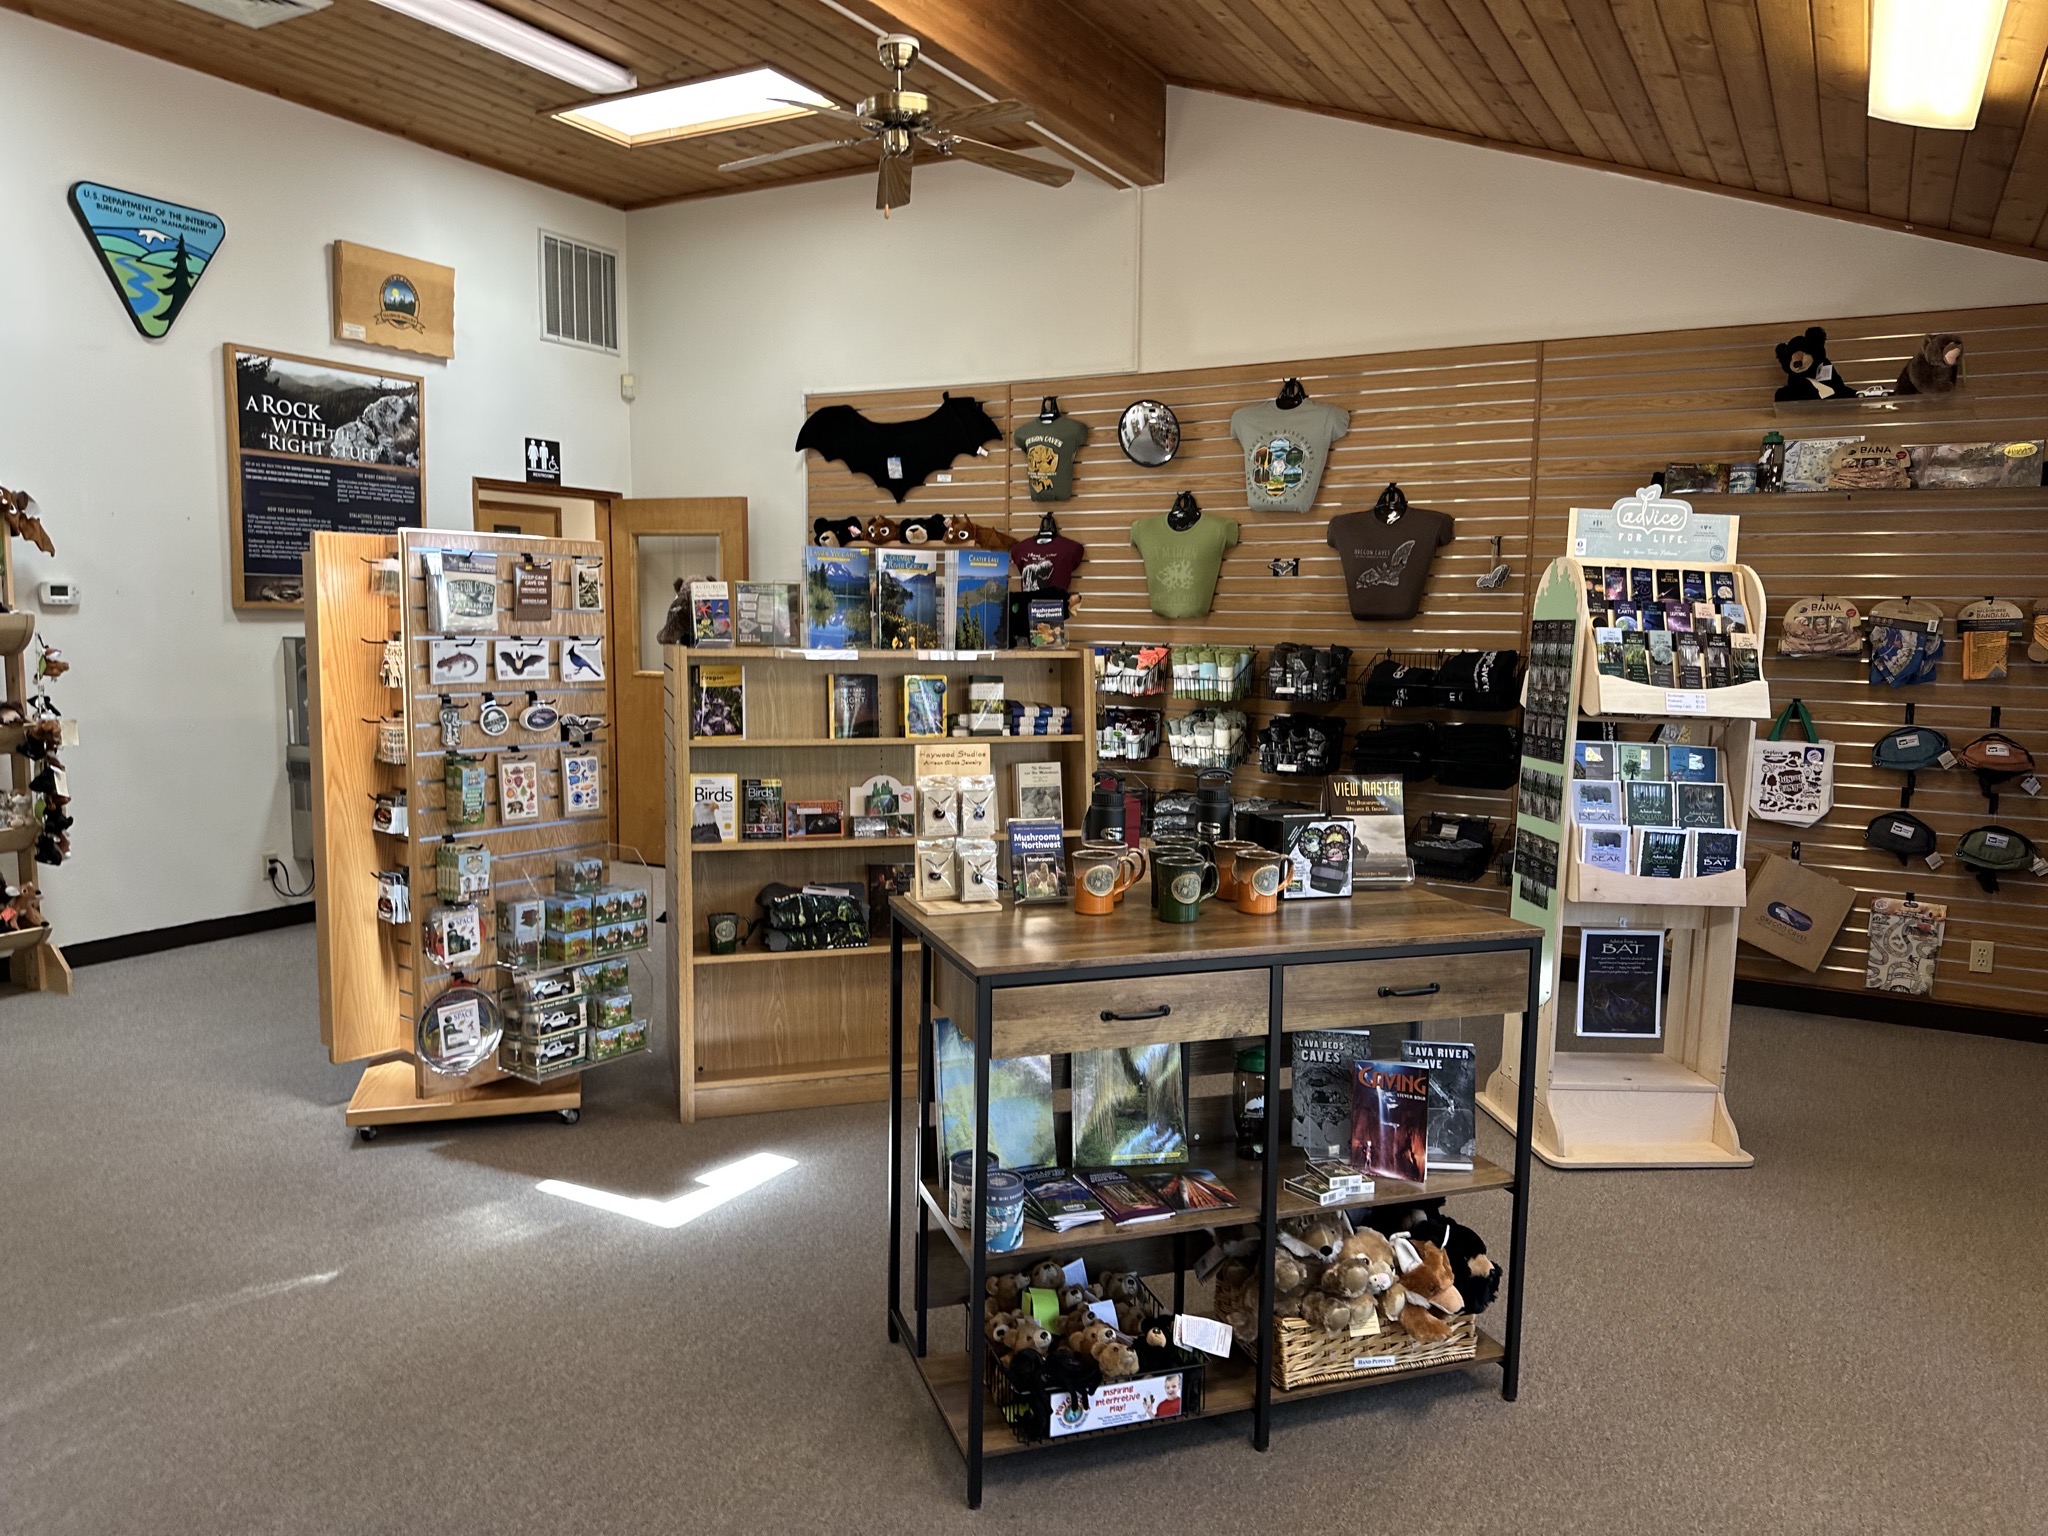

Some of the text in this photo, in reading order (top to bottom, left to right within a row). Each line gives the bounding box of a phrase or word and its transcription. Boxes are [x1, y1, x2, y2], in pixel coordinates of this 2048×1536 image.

[102, 194, 152, 213] DEPARTMENT
[156, 208, 166, 217] OF
[169, 212, 182, 221] THE
[185, 215, 218, 230] INTERIOR
[96, 203, 123, 215] BUREAU
[139, 214, 158, 224] LAND
[161, 219, 207, 235] MANAGEMENT
[246, 394, 322, 421] A ROCK
[272, 417, 329, 439] WITH
[1045, 436, 1063, 448] CAVES
[1622, 501, 1683, 526] advice
[1618, 533, 1683, 543] FOR LIFE
[968, 554, 986, 562] CRATER
[475, 582, 494, 594] CAVES
[920, 751, 955, 760] Haywood
[694, 786, 733, 802] Birds
[748, 787, 773, 797] Birds
[1334, 781, 1400, 796] VIEW MASTER
[1578, 813, 1615, 821] BEAR
[1014, 834, 1060, 842] Mushrooms
[1021, 840, 1061, 849] Northwest
[455, 916, 475, 926] SPACE
[1759, 915, 1786, 933] OREGON
[1788, 928, 1807, 941] CAVES
[1602, 943, 1645, 954] BAT
[453, 1011, 474, 1020] SPACE
[1299, 1040, 1344, 1050] LAVA BEDS
[1301, 1050, 1341, 1064] CAVES
[1409, 1047, 1469, 1059] LAVA RIVER
[559, 1062, 572, 1070] Model
[1358, 1067, 1426, 1095] CAVING
[1109, 1405, 1126, 1413] Play!
